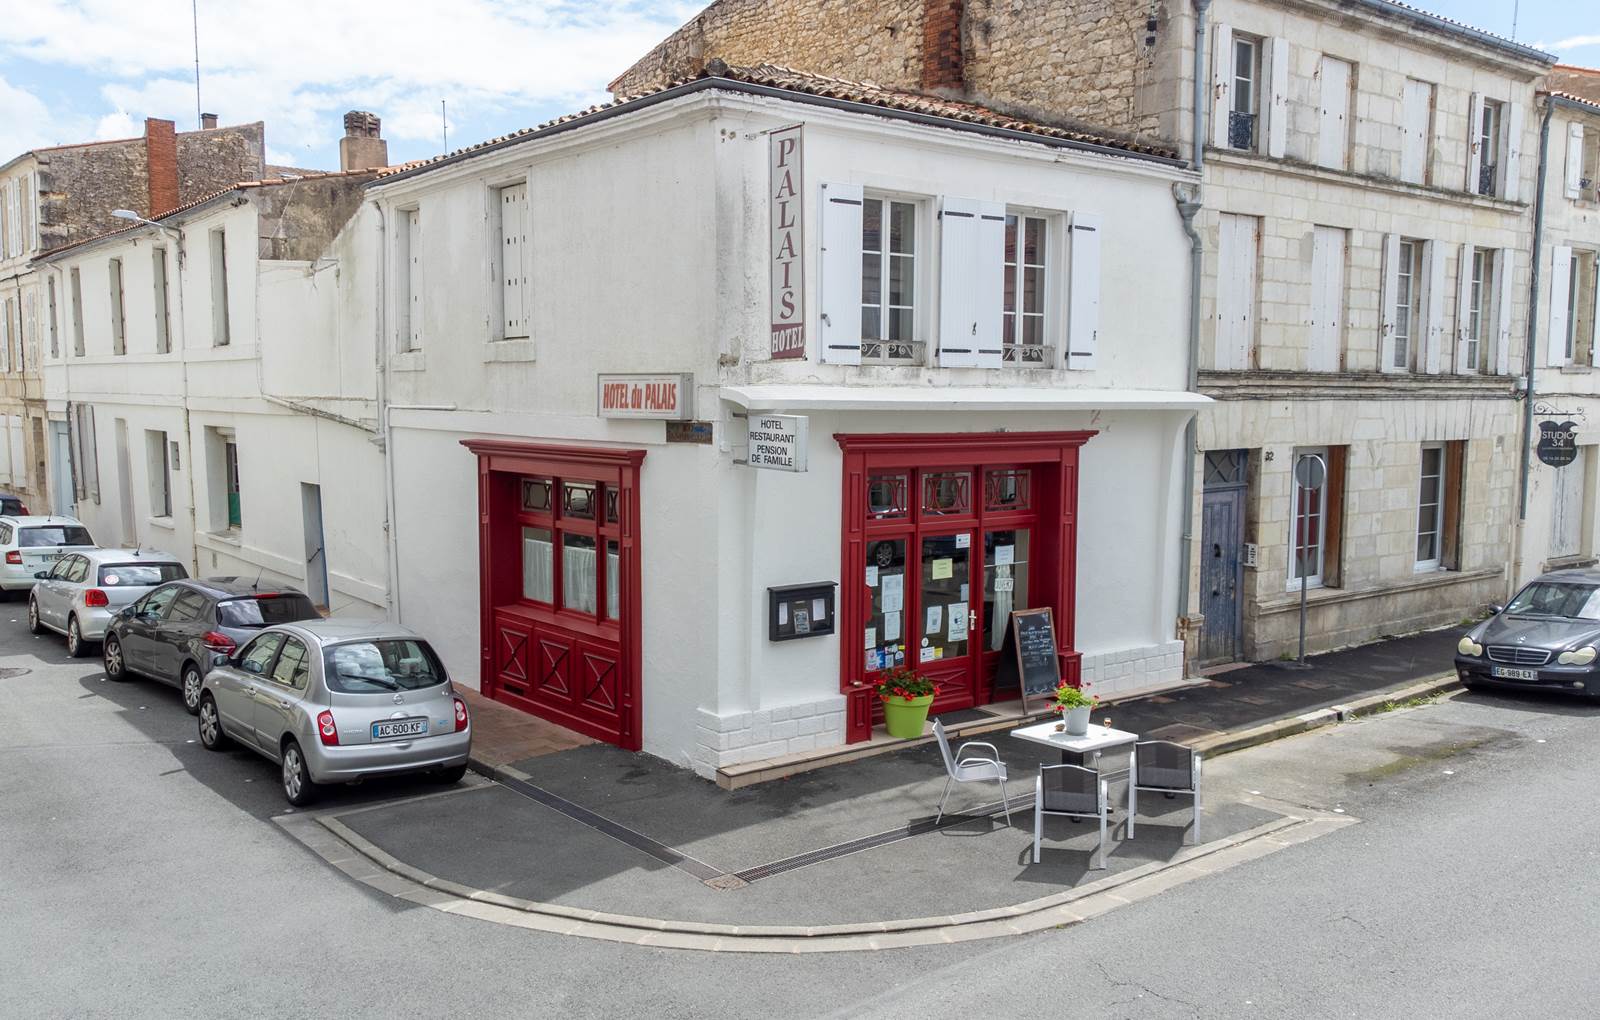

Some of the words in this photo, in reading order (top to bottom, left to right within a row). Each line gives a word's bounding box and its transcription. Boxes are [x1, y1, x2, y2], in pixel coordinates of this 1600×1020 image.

[775, 137, 798, 320] PALAIS
[772, 325, 804, 353] HOTEL
[603, 383, 629, 409] HOTEL
[631, 383, 642, 409] du
[645, 383, 676, 410] PALAIS
[760, 419, 784, 430] HOTEL
[749, 431, 795, 444] RESTAURANT
[1542, 431, 1575, 440] STUDIO
[756, 444, 788, 456] PENSION
[751, 453, 761, 463] DE
[763, 454, 793, 467] FAMILLE
